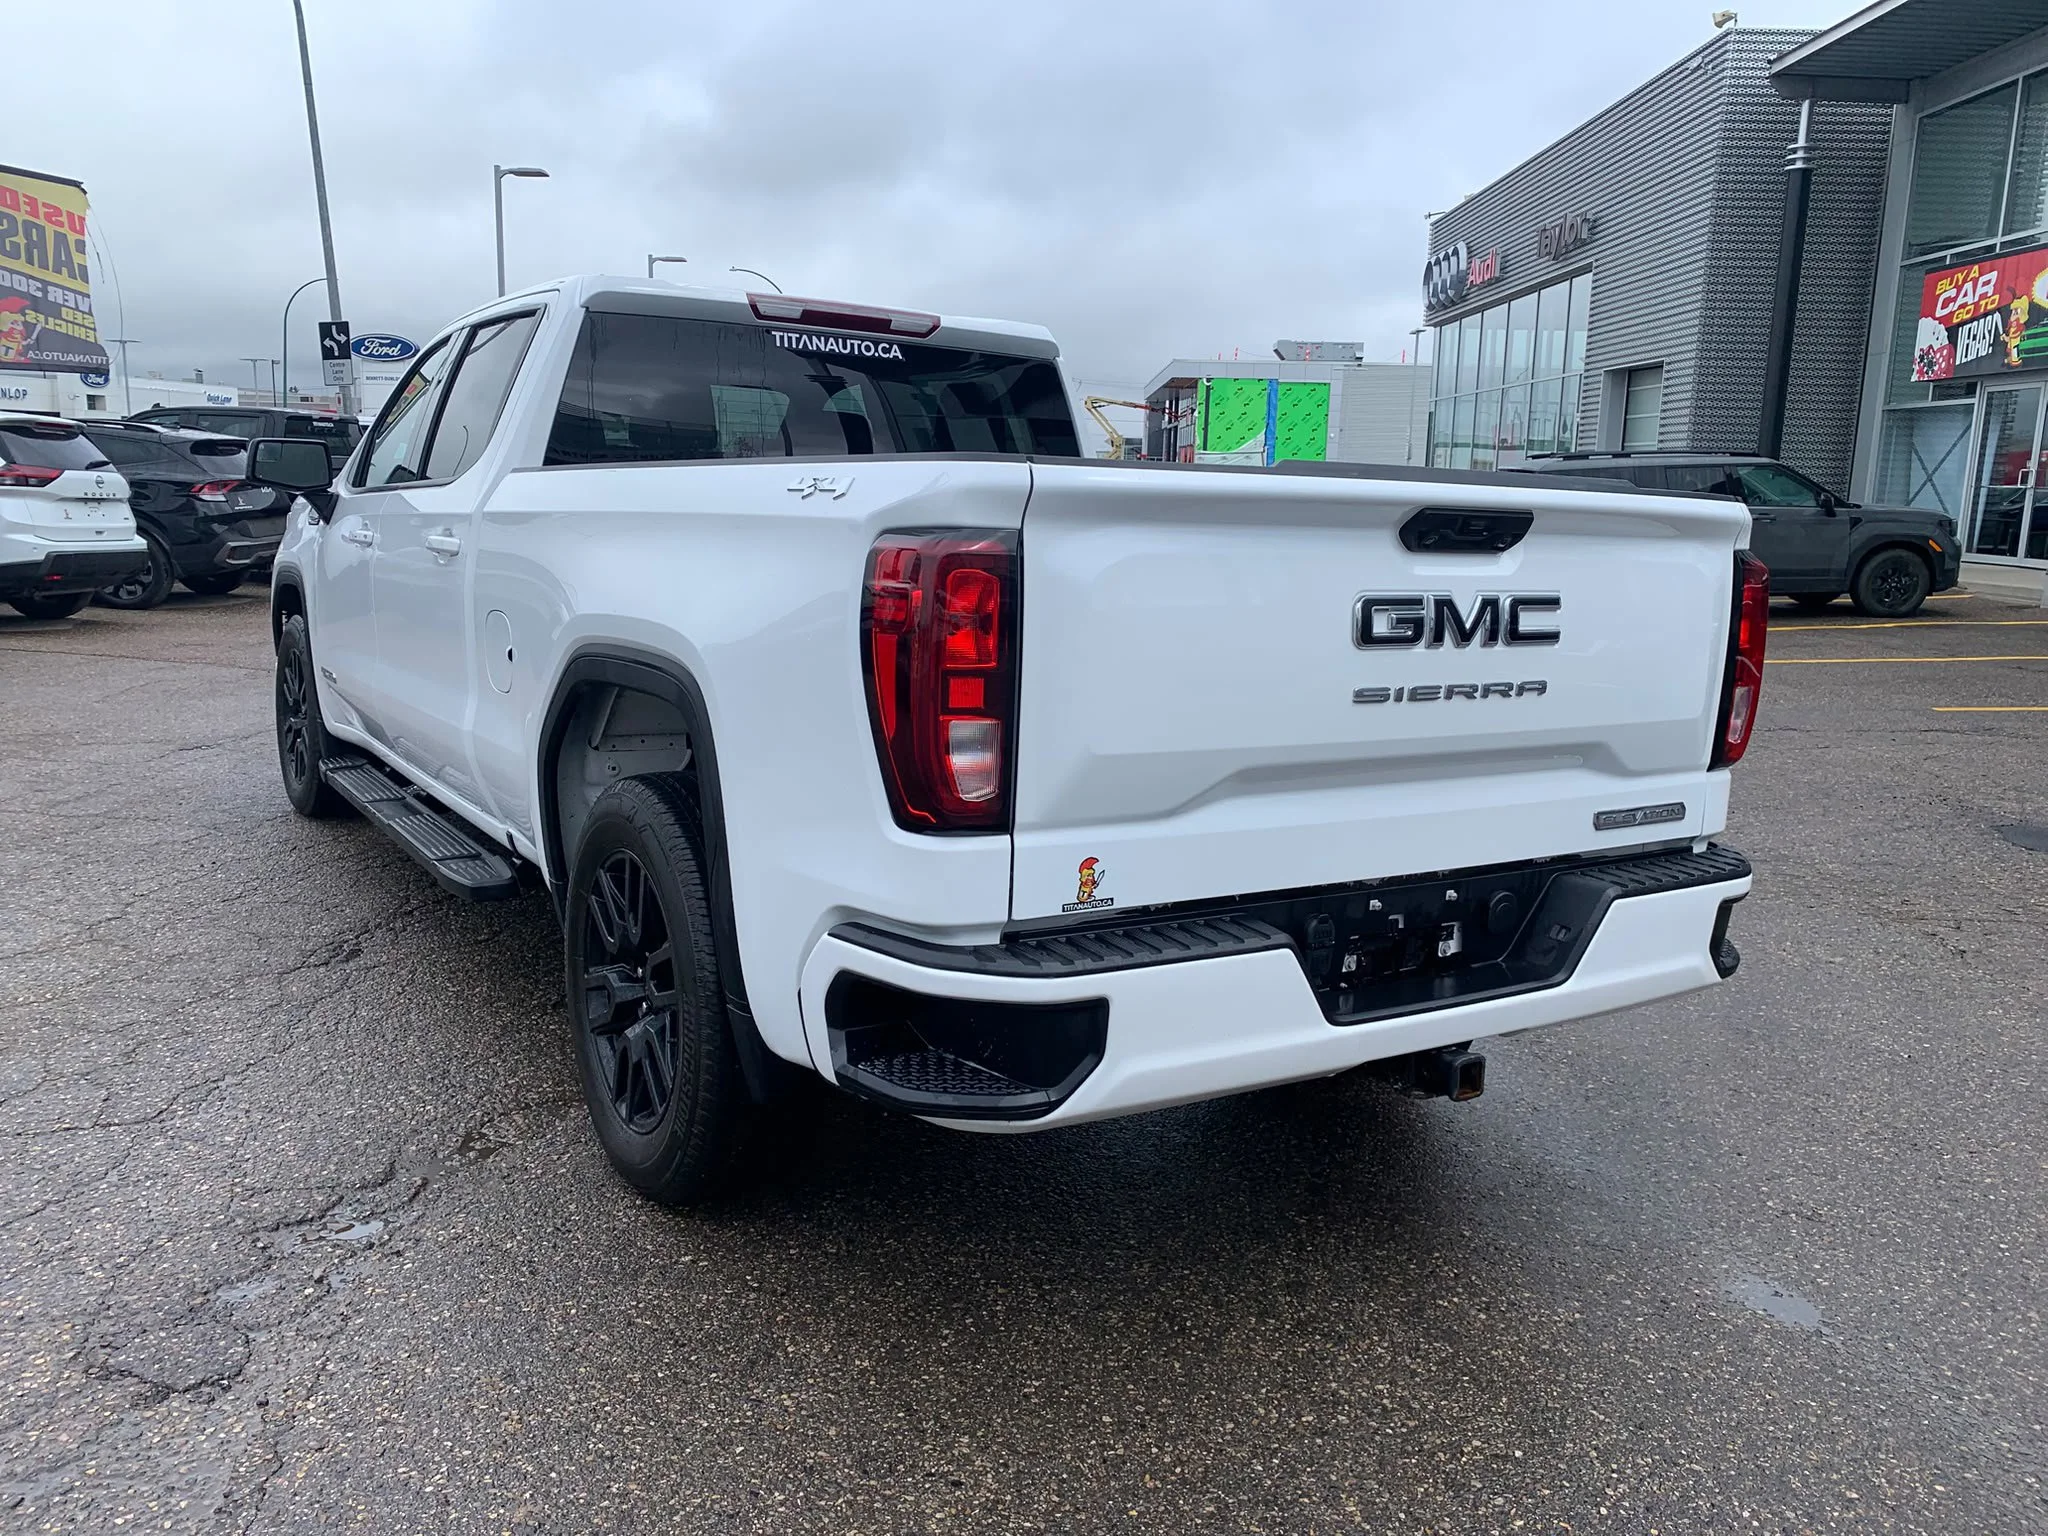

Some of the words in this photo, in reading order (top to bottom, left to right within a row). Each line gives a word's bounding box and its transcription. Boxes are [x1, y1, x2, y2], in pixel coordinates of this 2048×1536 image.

[1536, 211, 1592, 260] Taylor
[1467, 248, 1499, 287] Audi
[1936, 270, 1967, 296] BUY
[1967, 264, 1979, 279] A
[1935, 270, 1998, 318] CAR
[1952, 304, 1974, 323] GO
[1979, 294, 1999, 313] TO
[361, 337, 402, 356] Ford
[771, 330, 903, 360] TITANAUTO.CA
[1955, 313, 1998, 366] VEGAS!
[1352, 591, 1562, 651] GMC
[1351, 680, 1549, 704] SIERRA
[1063, 898, 1113, 912] TITANAUTO.CA
